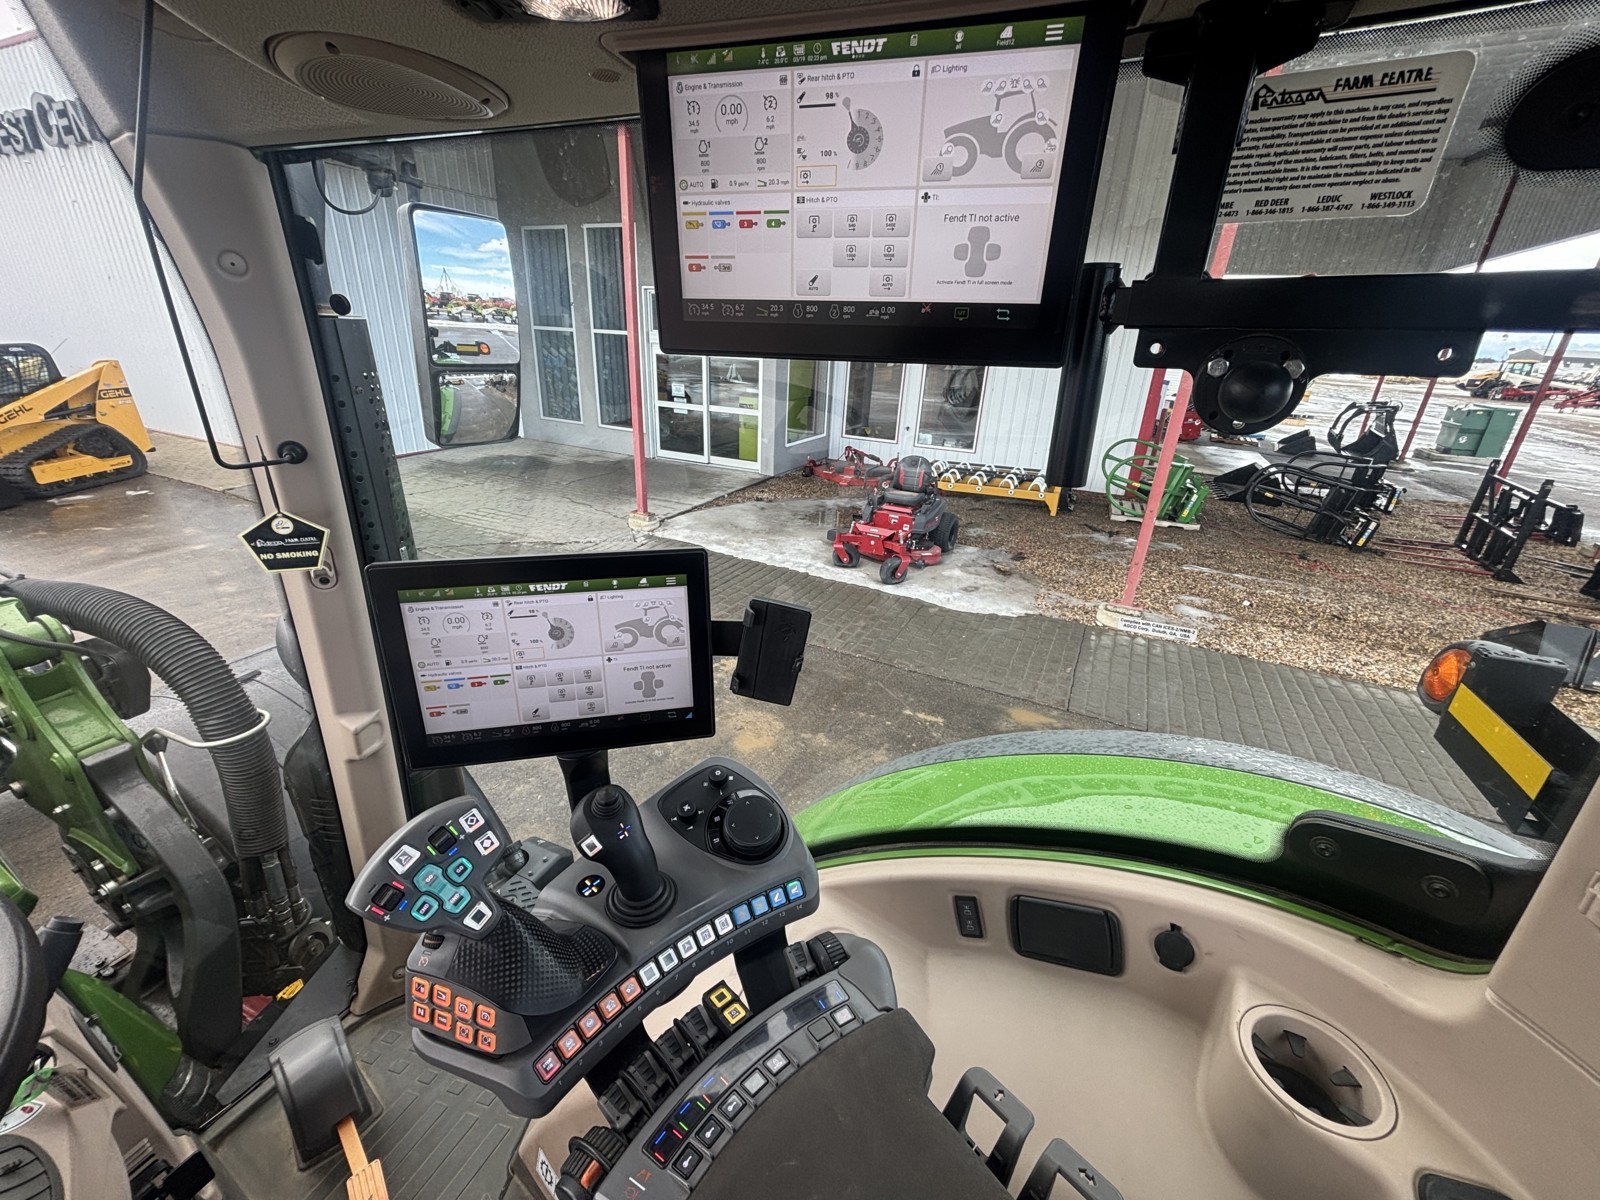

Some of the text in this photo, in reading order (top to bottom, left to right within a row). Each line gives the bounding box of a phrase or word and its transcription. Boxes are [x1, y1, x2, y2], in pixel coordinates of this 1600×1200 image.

[831, 38, 888, 55] FENDT
[942, 64, 968, 73] Lighting
[1334, 74, 1374, 91] FARM
[1380, 67, 1432, 86] CENTRE
[685, 84, 702, 92] Engine
[708, 81, 743, 89] Transmission
[721, 103, 742, 115] 0.00
[31, 92, 93, 147] CEN
[726, 118, 738, 126] mph
[1317, 195, 1342, 204] LEDUC
[1370, 191, 1413, 200] WESTLOCK
[1270, 198, 1289, 206] DEER
[1361, 201, 1415, 209] 1-866-349-3113
[1246, 208, 1294, 216] 1-866-346-1815
[1302, 204, 1353, 212] 1-866-387-4747
[944, 214, 966, 222] Fendt
[969, 214, 976, 222] TI
[979, 214, 993, 222] not
[100, 390, 130, 398] GEHL
[0, 404, 33, 424] GEHL
[276, 551, 318, 559] SMOKING
[528, 582, 568, 591] FENDT
[450, 893, 460, 903] END
[420, 904, 429, 914] END
[418, 1008, 424, 1016] N
